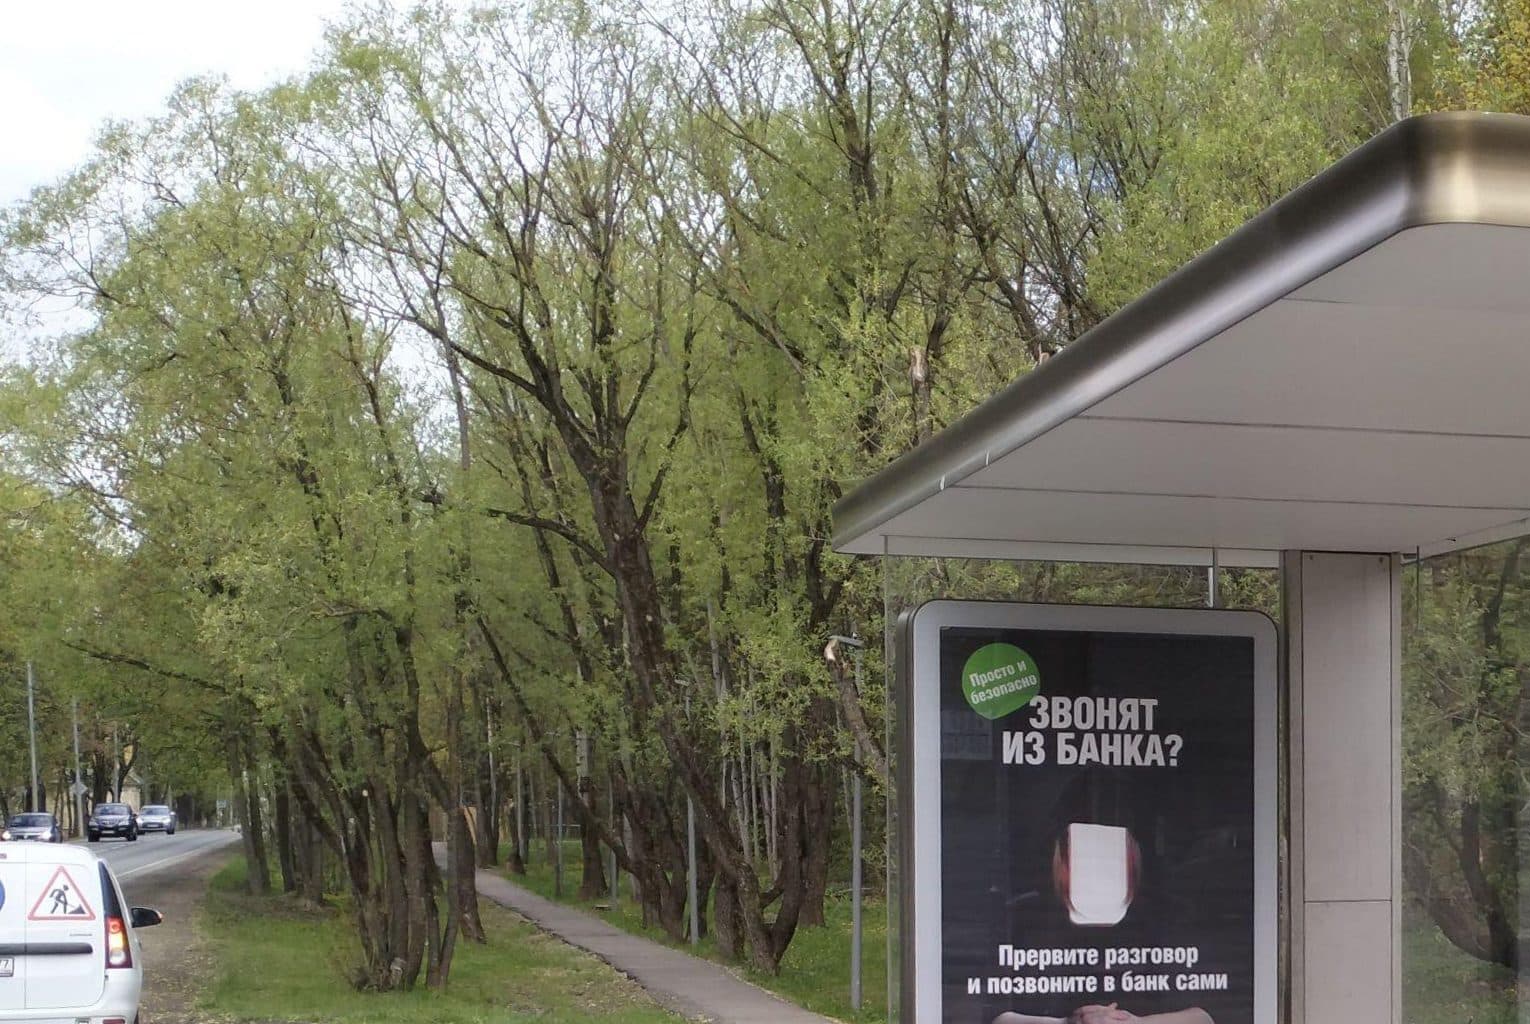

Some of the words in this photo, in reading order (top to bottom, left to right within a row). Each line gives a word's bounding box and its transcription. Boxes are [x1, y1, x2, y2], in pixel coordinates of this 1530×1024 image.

[969, 664, 1016, 688] Просто
[1017, 660, 1027, 672] и
[970, 674, 1038, 705] безопасно
[1029, 695, 1159, 731] ЗВОНЯТ
[1002, 731, 1046, 765] ИЗ
[1056, 732, 1184, 767] БАНКА?
[998, 944, 1099, 970] Прервите
[1104, 946, 1199, 970] разговор
[967, 978, 981, 994] и
[987, 975, 1098, 994] позвоните
[1103, 976, 1115, 992] в
[1121, 971, 1170, 992] банк
[1175, 973, 1228, 990] сами
